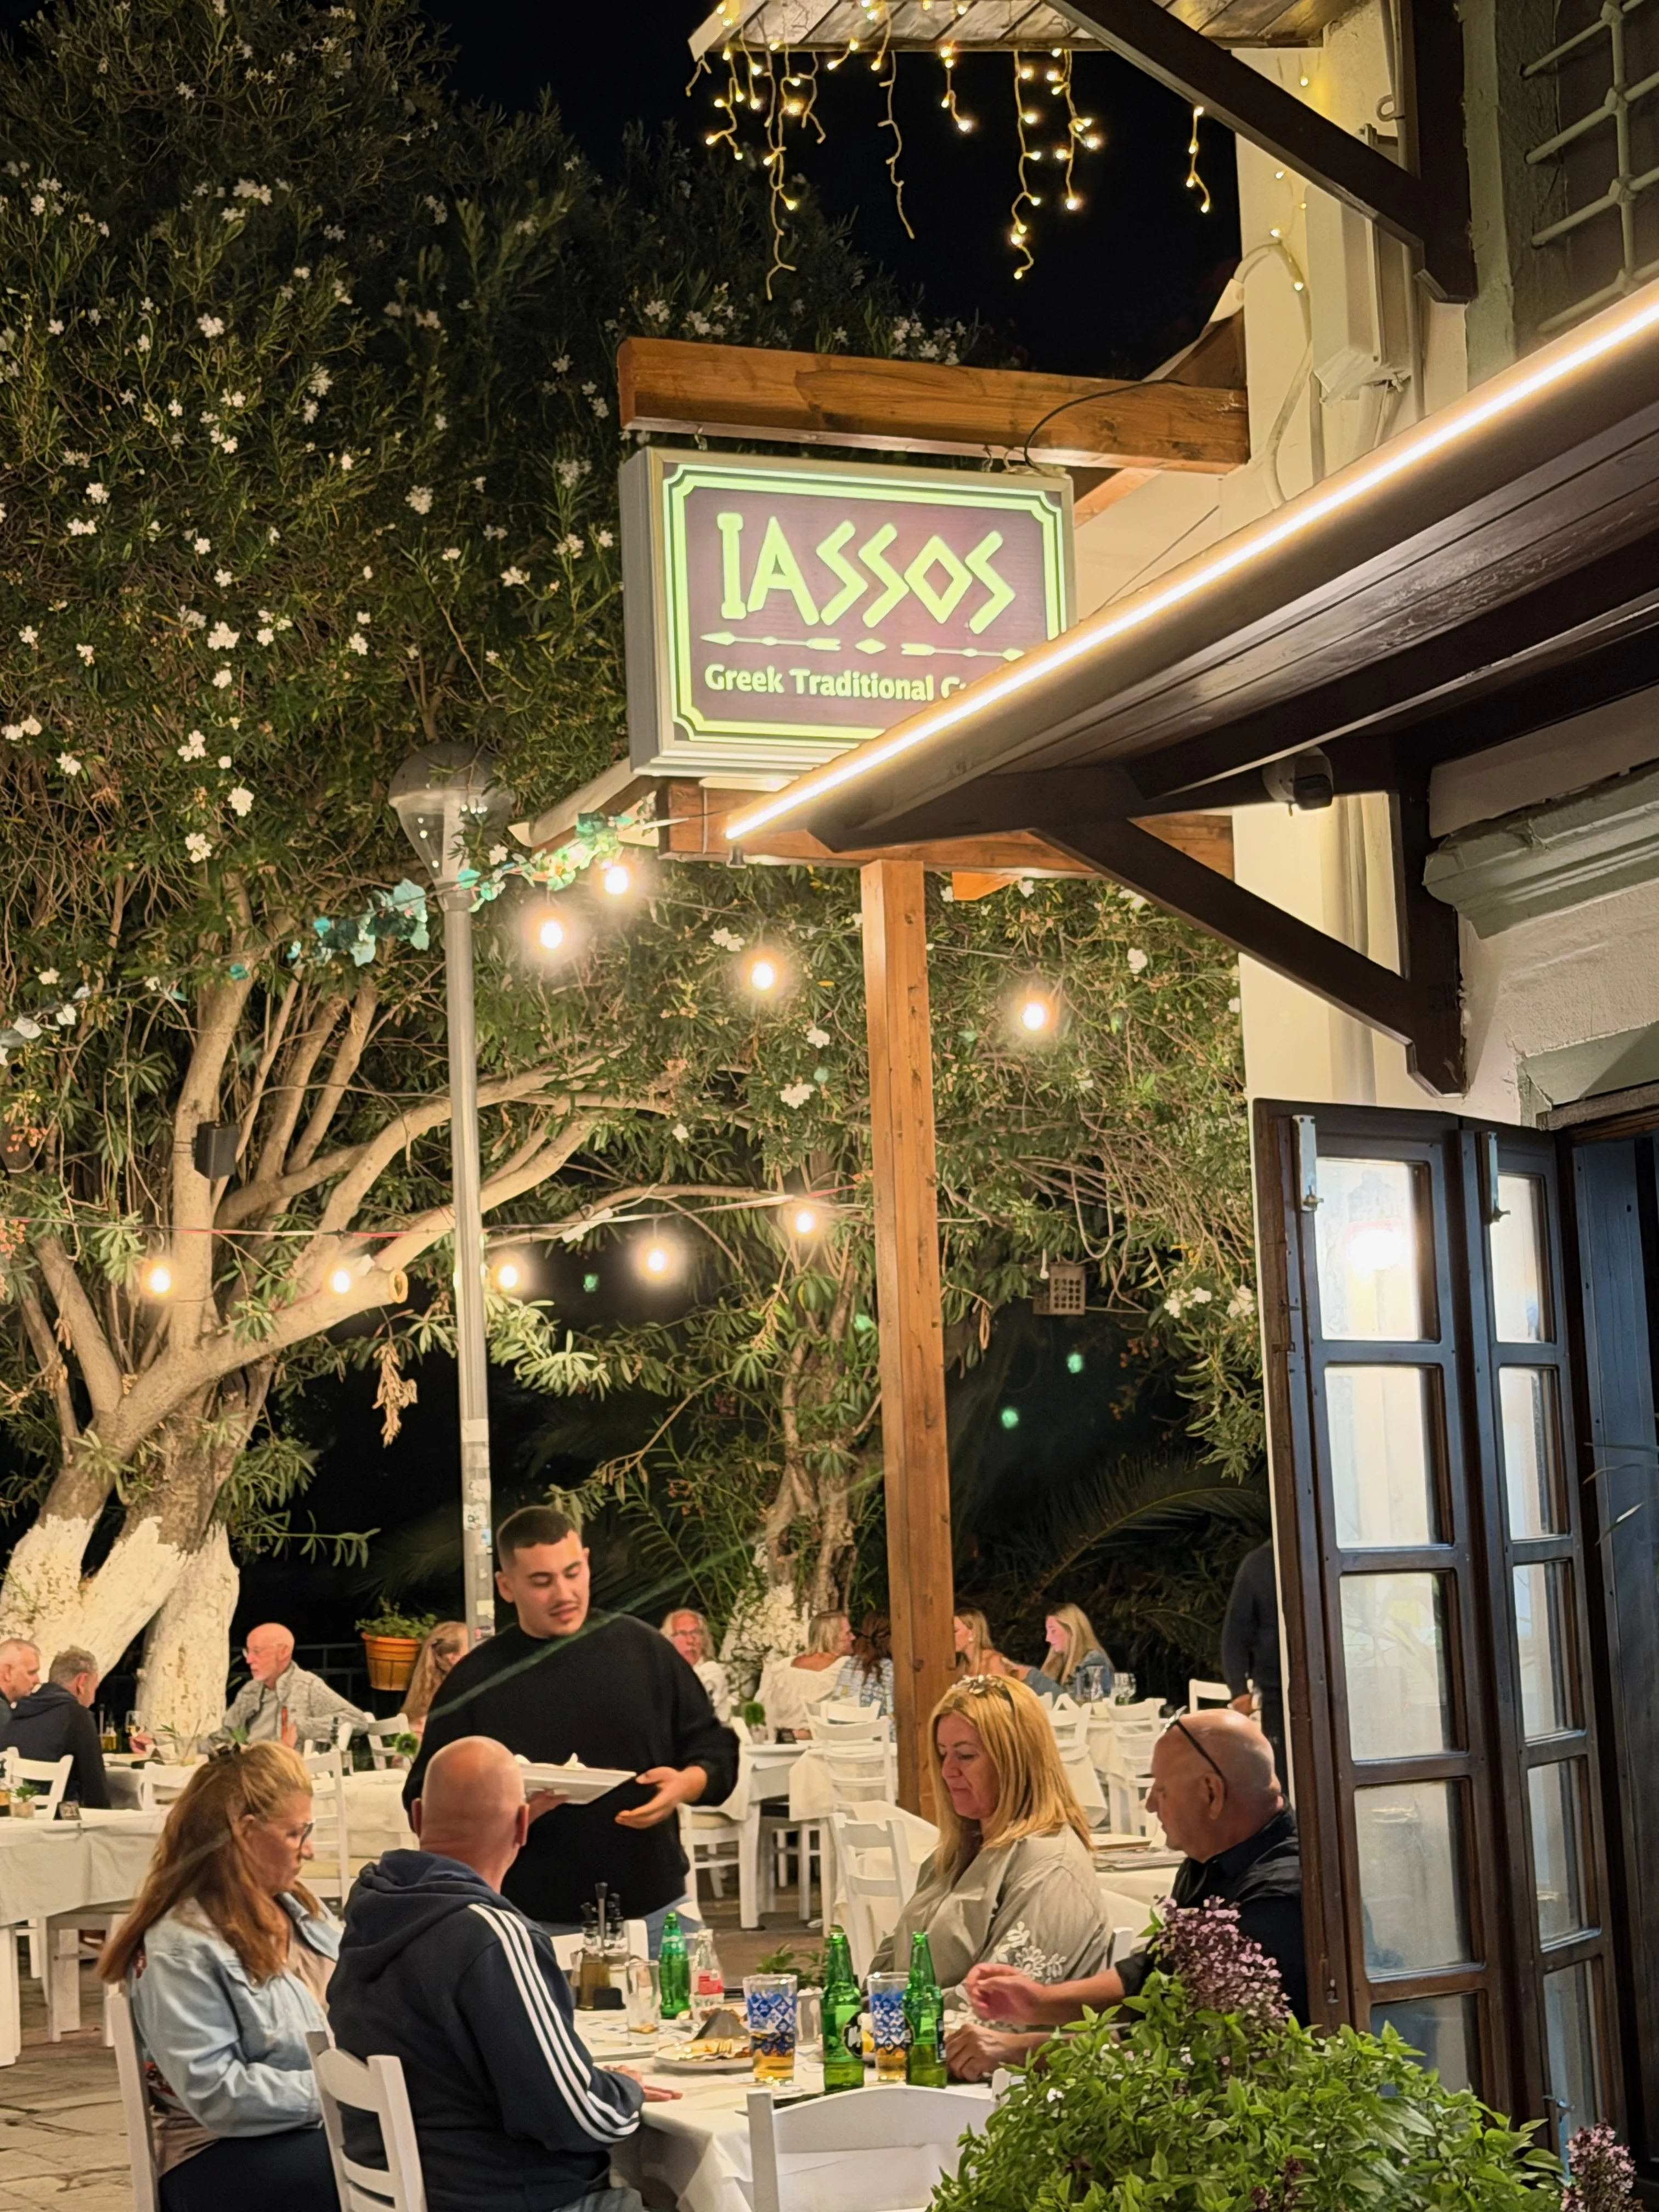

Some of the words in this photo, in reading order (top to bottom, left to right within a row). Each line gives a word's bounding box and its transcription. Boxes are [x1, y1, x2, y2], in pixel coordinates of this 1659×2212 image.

[717, 512, 1016, 634] IASSOS
[704, 663, 785, 693] Greek
[789, 668, 934, 701] Traditional
